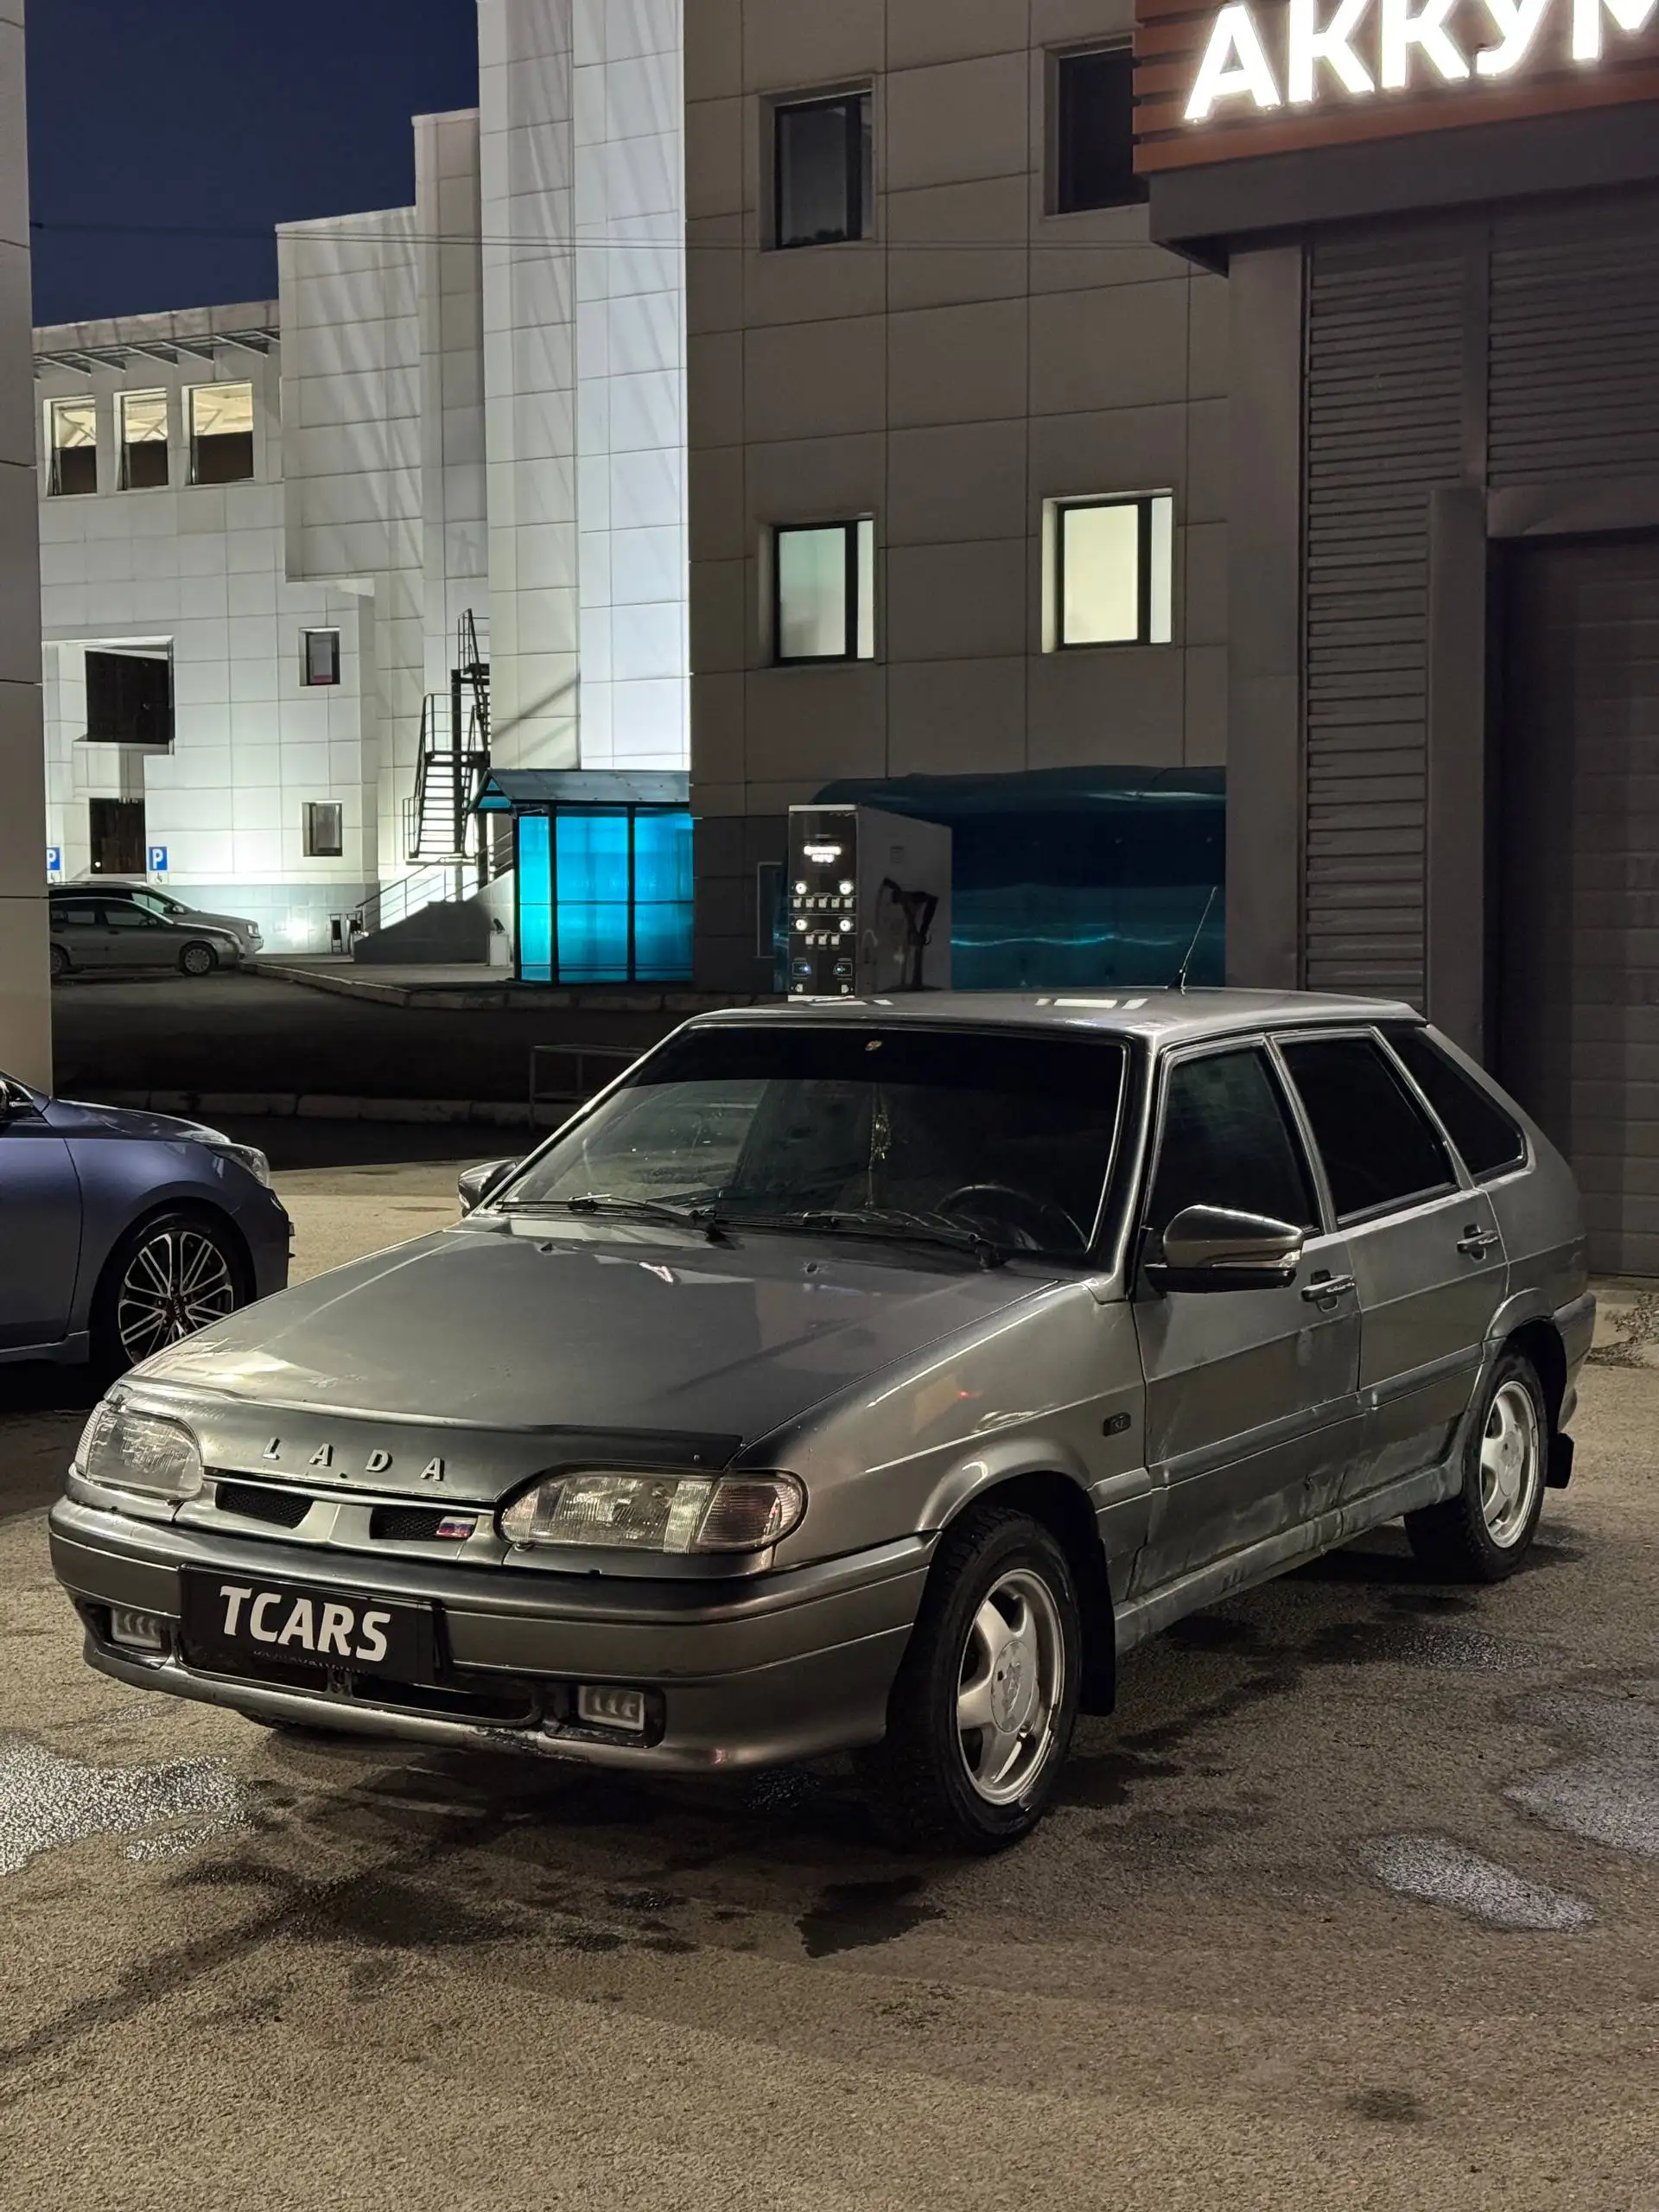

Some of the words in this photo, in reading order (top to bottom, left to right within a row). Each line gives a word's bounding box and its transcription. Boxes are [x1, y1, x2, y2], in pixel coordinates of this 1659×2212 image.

[152, 849, 163, 869] P
[262, 1437, 445, 1481] LADA
[219, 1585, 391, 1662] TCARS
